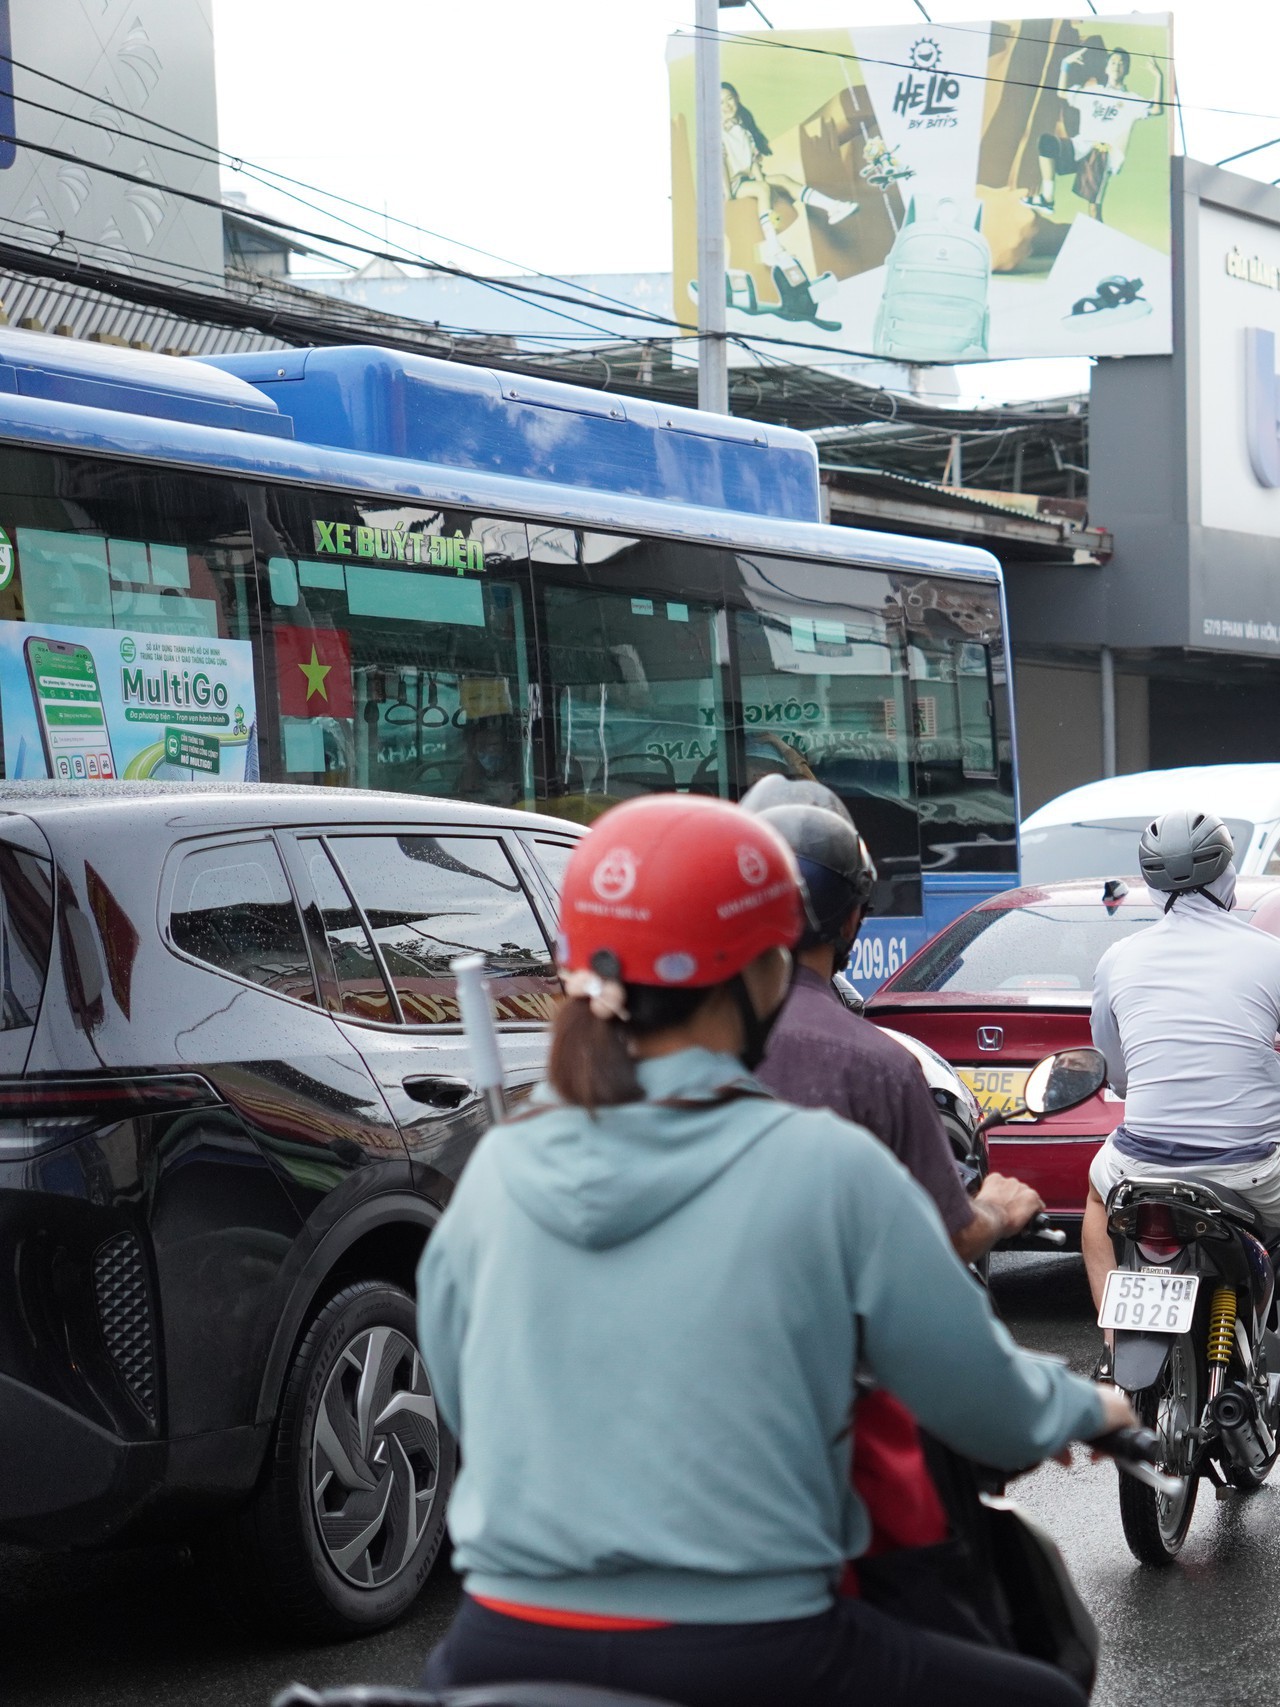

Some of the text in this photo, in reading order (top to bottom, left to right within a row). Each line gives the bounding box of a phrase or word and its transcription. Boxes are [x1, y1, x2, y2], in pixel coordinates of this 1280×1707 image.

[316, 520, 485, 576] XE BUÝT ĐIỆN
[121, 667, 229, 708] MultiGo
[973, 1072, 1014, 1094] 50E
[1119, 1276, 1184, 1302] 55-Y9
[1114, 1301, 1180, 1328] 0926
